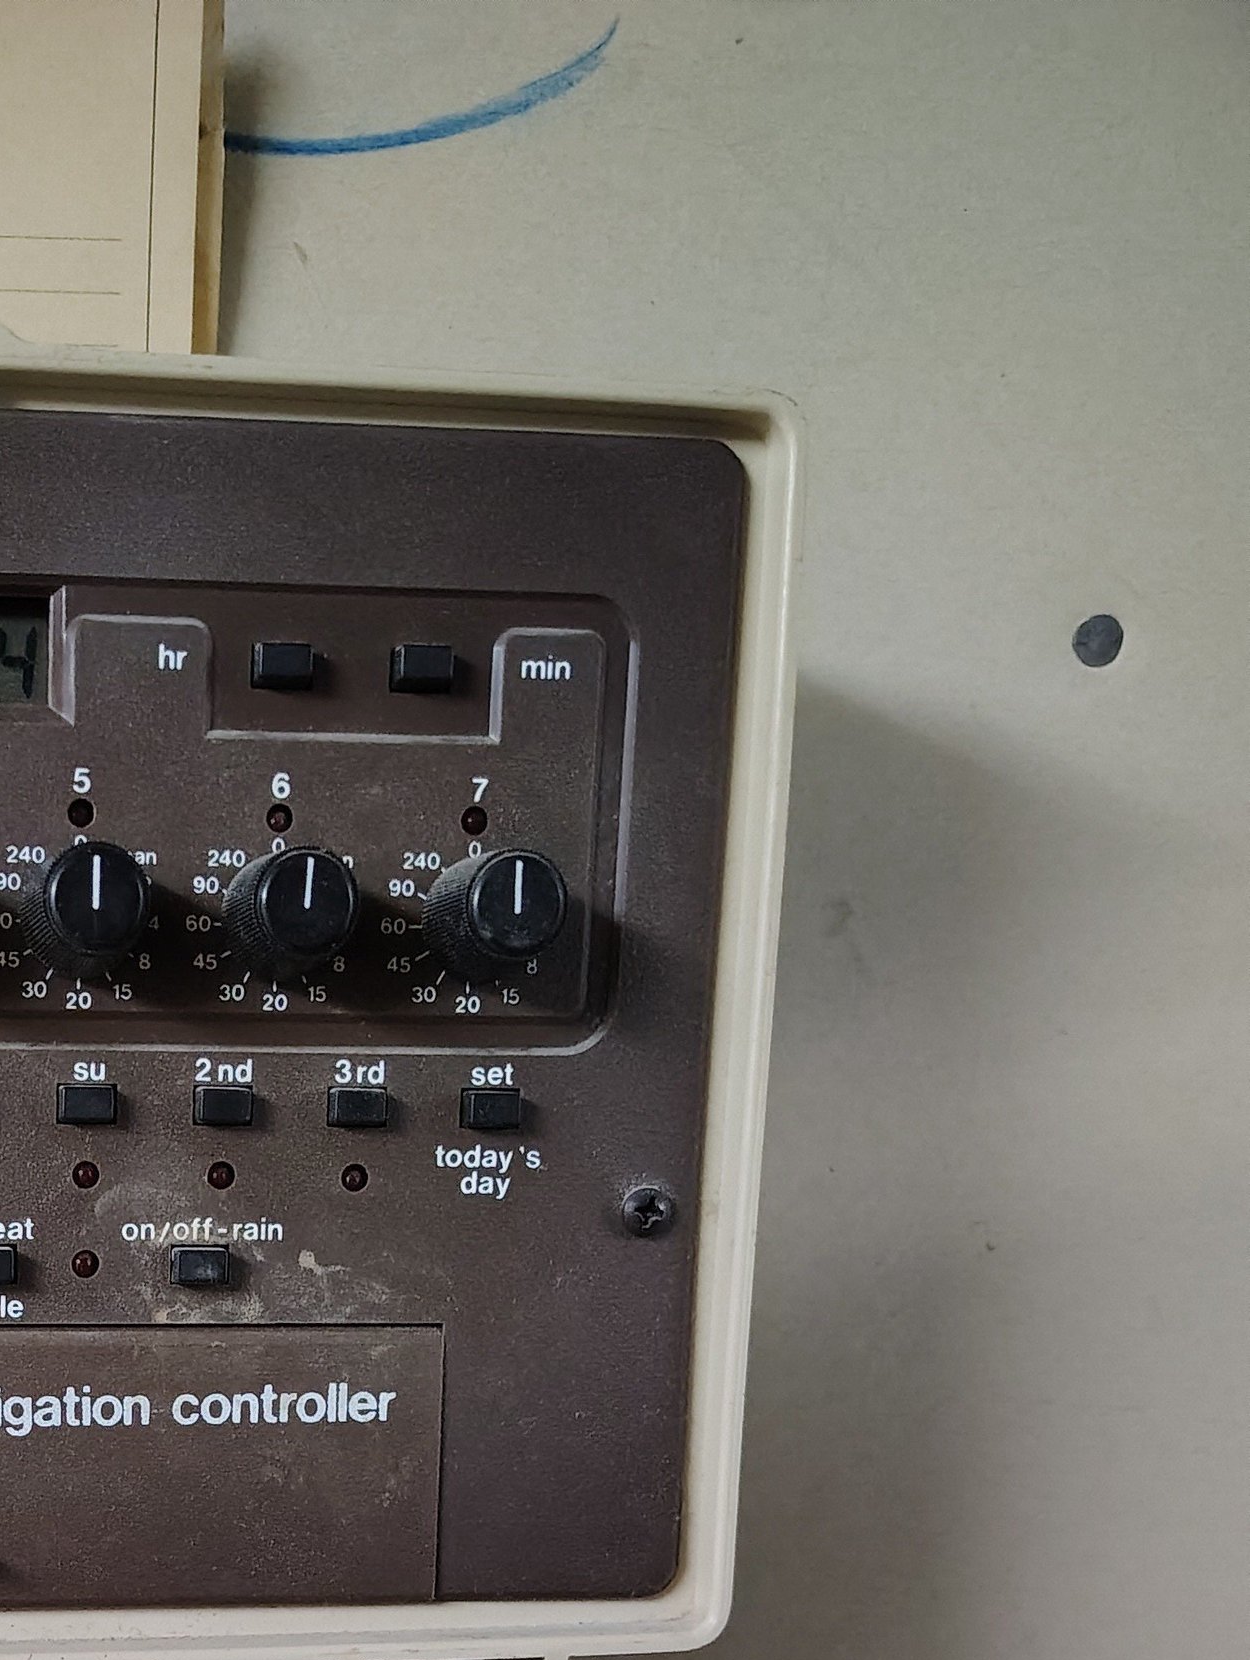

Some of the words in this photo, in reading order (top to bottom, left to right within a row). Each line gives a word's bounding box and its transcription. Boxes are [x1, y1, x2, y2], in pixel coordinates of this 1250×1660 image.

[159, 644, 187, 670] hr
[522, 655, 570, 680] min
[73, 768, 91, 793] 5
[272, 773, 290, 798] 6
[472, 777, 488, 802] 7
[6, 846, 45, 864] 240
[403, 852, 440, 870] 240
[456, 996, 480, 1013] 20
[74, 1062, 105, 1081] su
[195, 1058, 252, 1082] 2nd
[334, 1059, 384, 1084] 3rd
[471, 1063, 513, 1085] set
[461, 1171, 510, 1199] day
[172, 1383, 396, 1425] controller
